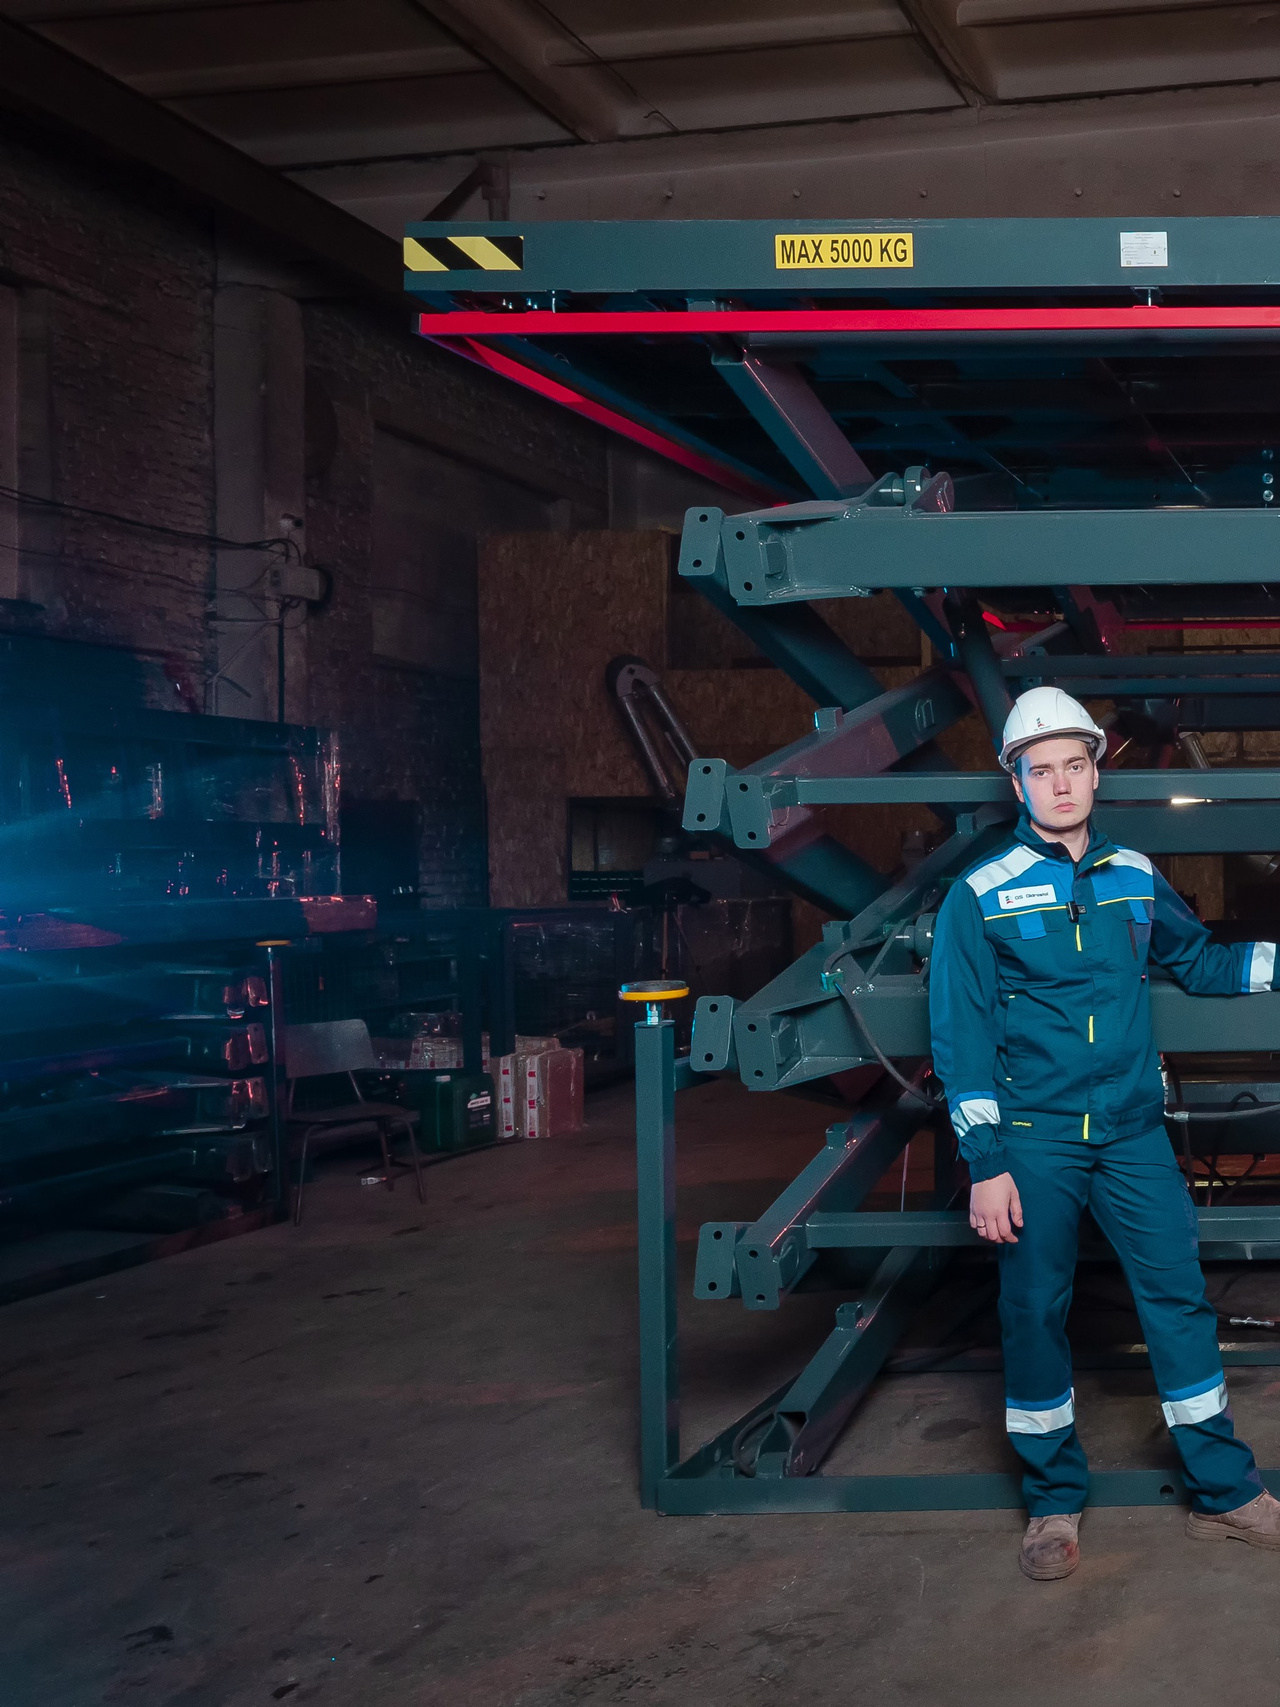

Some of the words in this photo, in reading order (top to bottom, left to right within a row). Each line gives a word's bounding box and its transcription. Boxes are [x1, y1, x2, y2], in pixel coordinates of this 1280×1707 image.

[781, 239, 824, 264] MAX
[830, 238, 873, 263] 5000
[879, 237, 908, 263] KG
